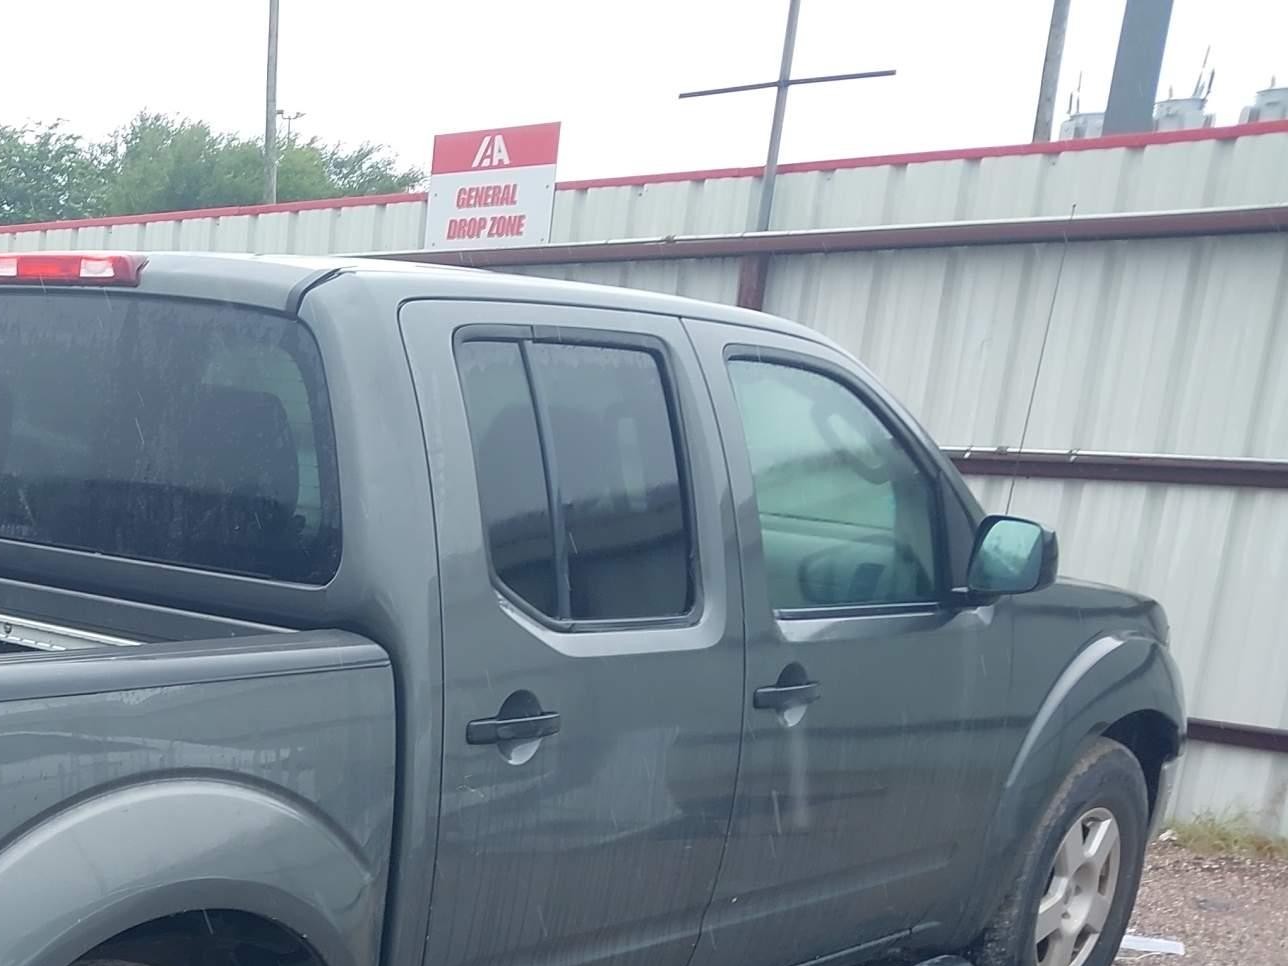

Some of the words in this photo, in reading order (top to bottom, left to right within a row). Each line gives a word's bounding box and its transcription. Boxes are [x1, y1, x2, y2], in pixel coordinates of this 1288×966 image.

[456, 183, 519, 210] GENERAL
[446, 217, 488, 241] DROP
[487, 214, 527, 238] ZONE
